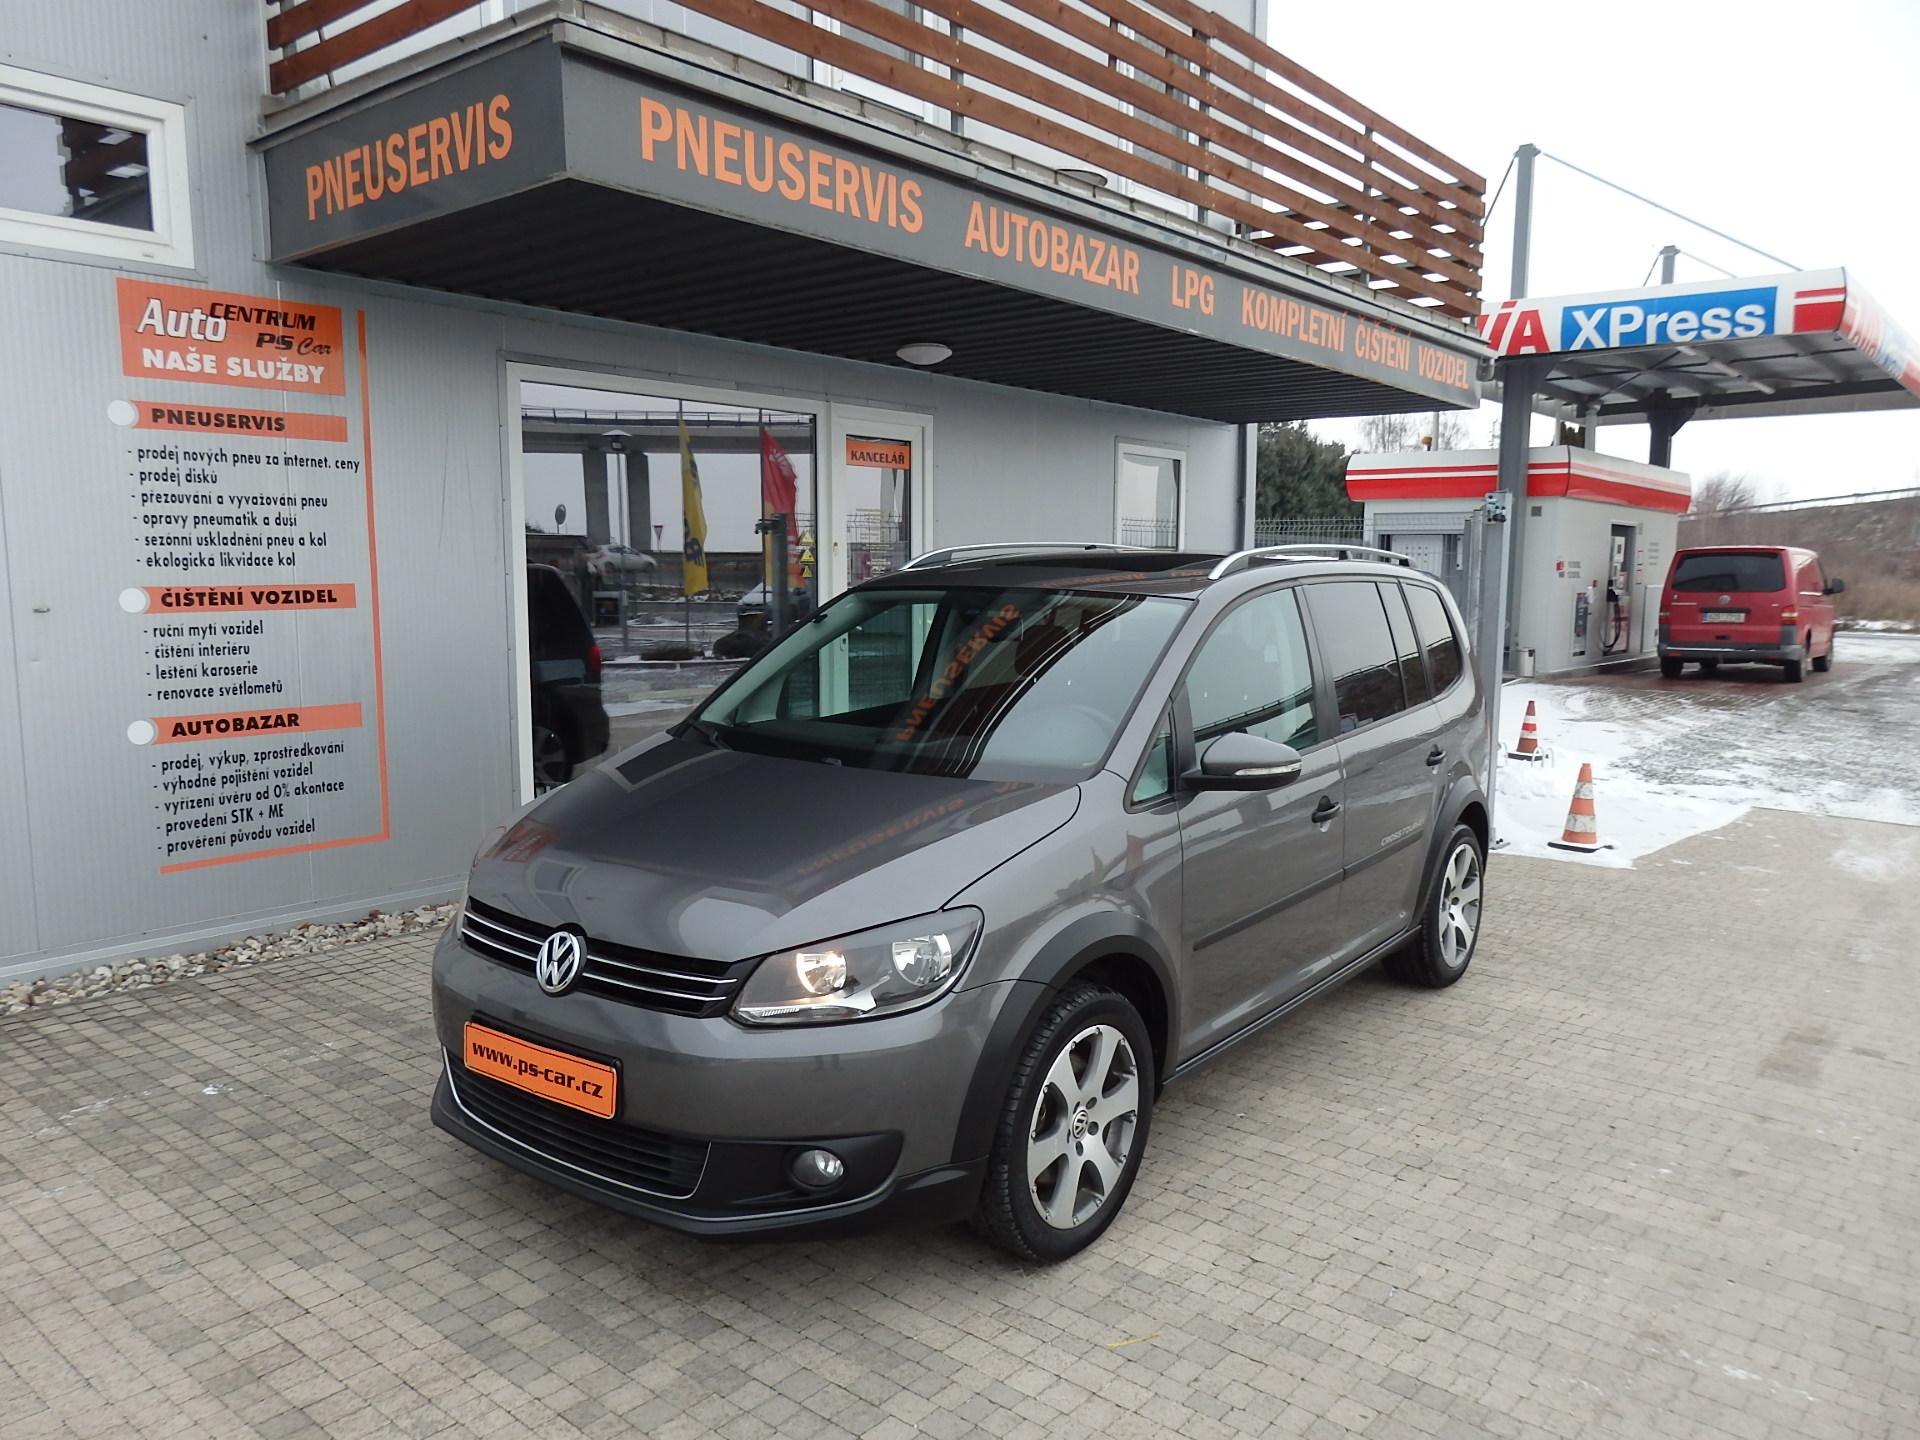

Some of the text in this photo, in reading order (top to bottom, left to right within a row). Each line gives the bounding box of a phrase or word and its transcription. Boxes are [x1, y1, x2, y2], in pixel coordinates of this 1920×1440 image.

[305, 94, 513, 221] PNEUSERVIS
[640, 96, 1470, 390] PNEUSERVIS AUTOBAZAR LPG KOMPLETNÍ ČIŠTĚNÍ VOZIDEL
[136, 297, 315, 342] Auto CENTRUM
[1570, 303, 1767, 352] XPress
[256, 332, 332, 356] PS Car
[143, 346, 325, 384] NAŠE SLUŽBY
[152, 408, 286, 431] PNEUSERVIS
[138, 445, 178, 464] prodej
[184, 448, 228, 466] nových
[233, 452, 261, 467] pneu
[266, 454, 279, 466] za
[335, 459, 360, 473] ceny
[140, 467, 180, 487] prodej
[217, 493, 223, 505] a
[302, 496, 327, 510] pneu
[143, 514, 188, 529] opravy
[194, 512, 257, 529] pneumatik
[263, 514, 269, 526] a
[267, 535, 294, 549] pneu
[299, 535, 305, 546] a
[310, 532, 326, 546] kol
[220, 552, 273, 567] likvidace
[278, 552, 295, 566] kol
[161, 586, 337, 607] ČIŠTĚNÍ VOZIDEL
[221, 620, 263, 635] vozidel
[202, 661, 257, 677] karoserie
[158, 687, 214, 700] renovace
[172, 713, 300, 737] AUTOBAZAR
[274, 761, 313, 780] vozidel
[256, 786, 269, 801] od
[295, 780, 344, 796] akontace
[231, 808, 254, 824] STK
[269, 803, 283, 819] ME
[276, 818, 315, 836] vozidel
[473, 1043, 603, 1098] www.ps-car.cz
